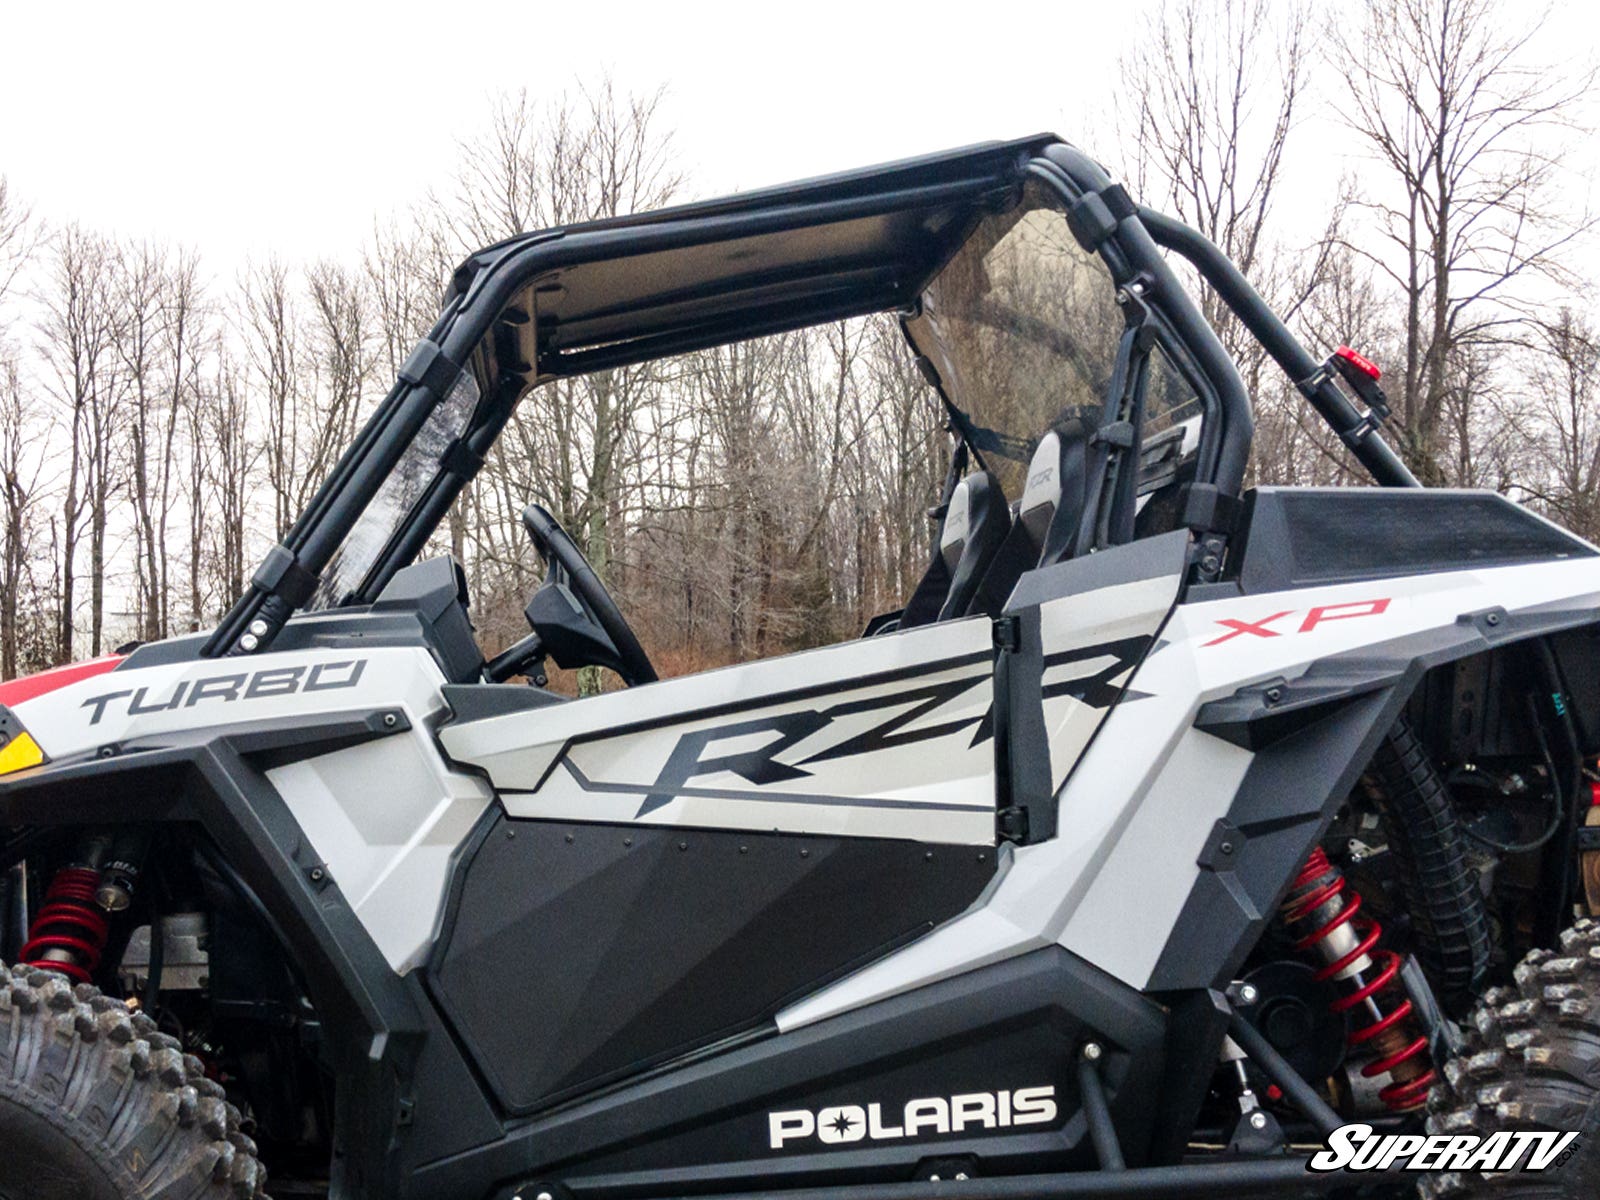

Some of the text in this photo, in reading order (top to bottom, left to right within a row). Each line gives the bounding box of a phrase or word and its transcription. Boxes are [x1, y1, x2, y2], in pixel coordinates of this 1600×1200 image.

[1198, 597, 1392, 648] XP
[80, 658, 368, 726] TURBO
[634, 633, 1166, 820] RZR
[768, 1085, 1058, 1148] POLARIS
